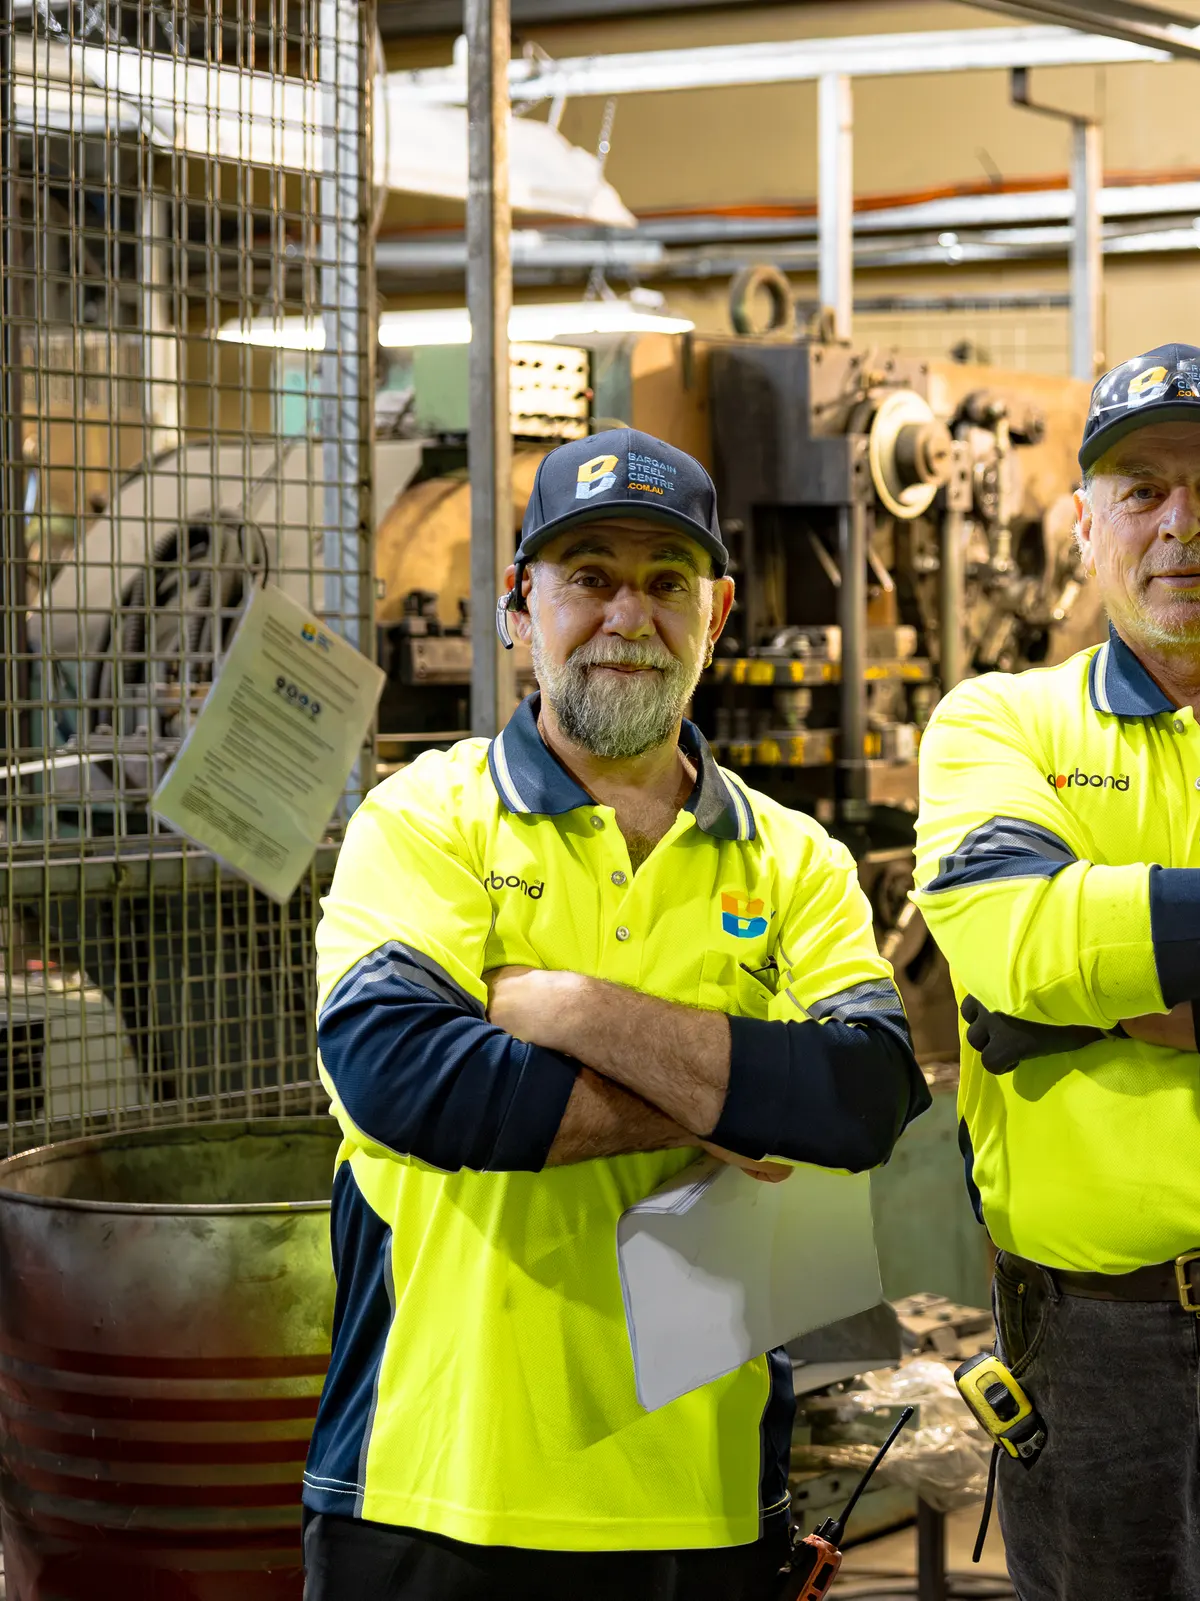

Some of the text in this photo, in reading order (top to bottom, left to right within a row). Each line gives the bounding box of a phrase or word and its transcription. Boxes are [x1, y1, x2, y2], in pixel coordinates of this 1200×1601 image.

[627, 452, 677, 475] BARGAIN
[627, 462, 665, 479] STEEL
[627, 472, 675, 491] CENTRE
[627, 482, 664, 495] .COM.AU
